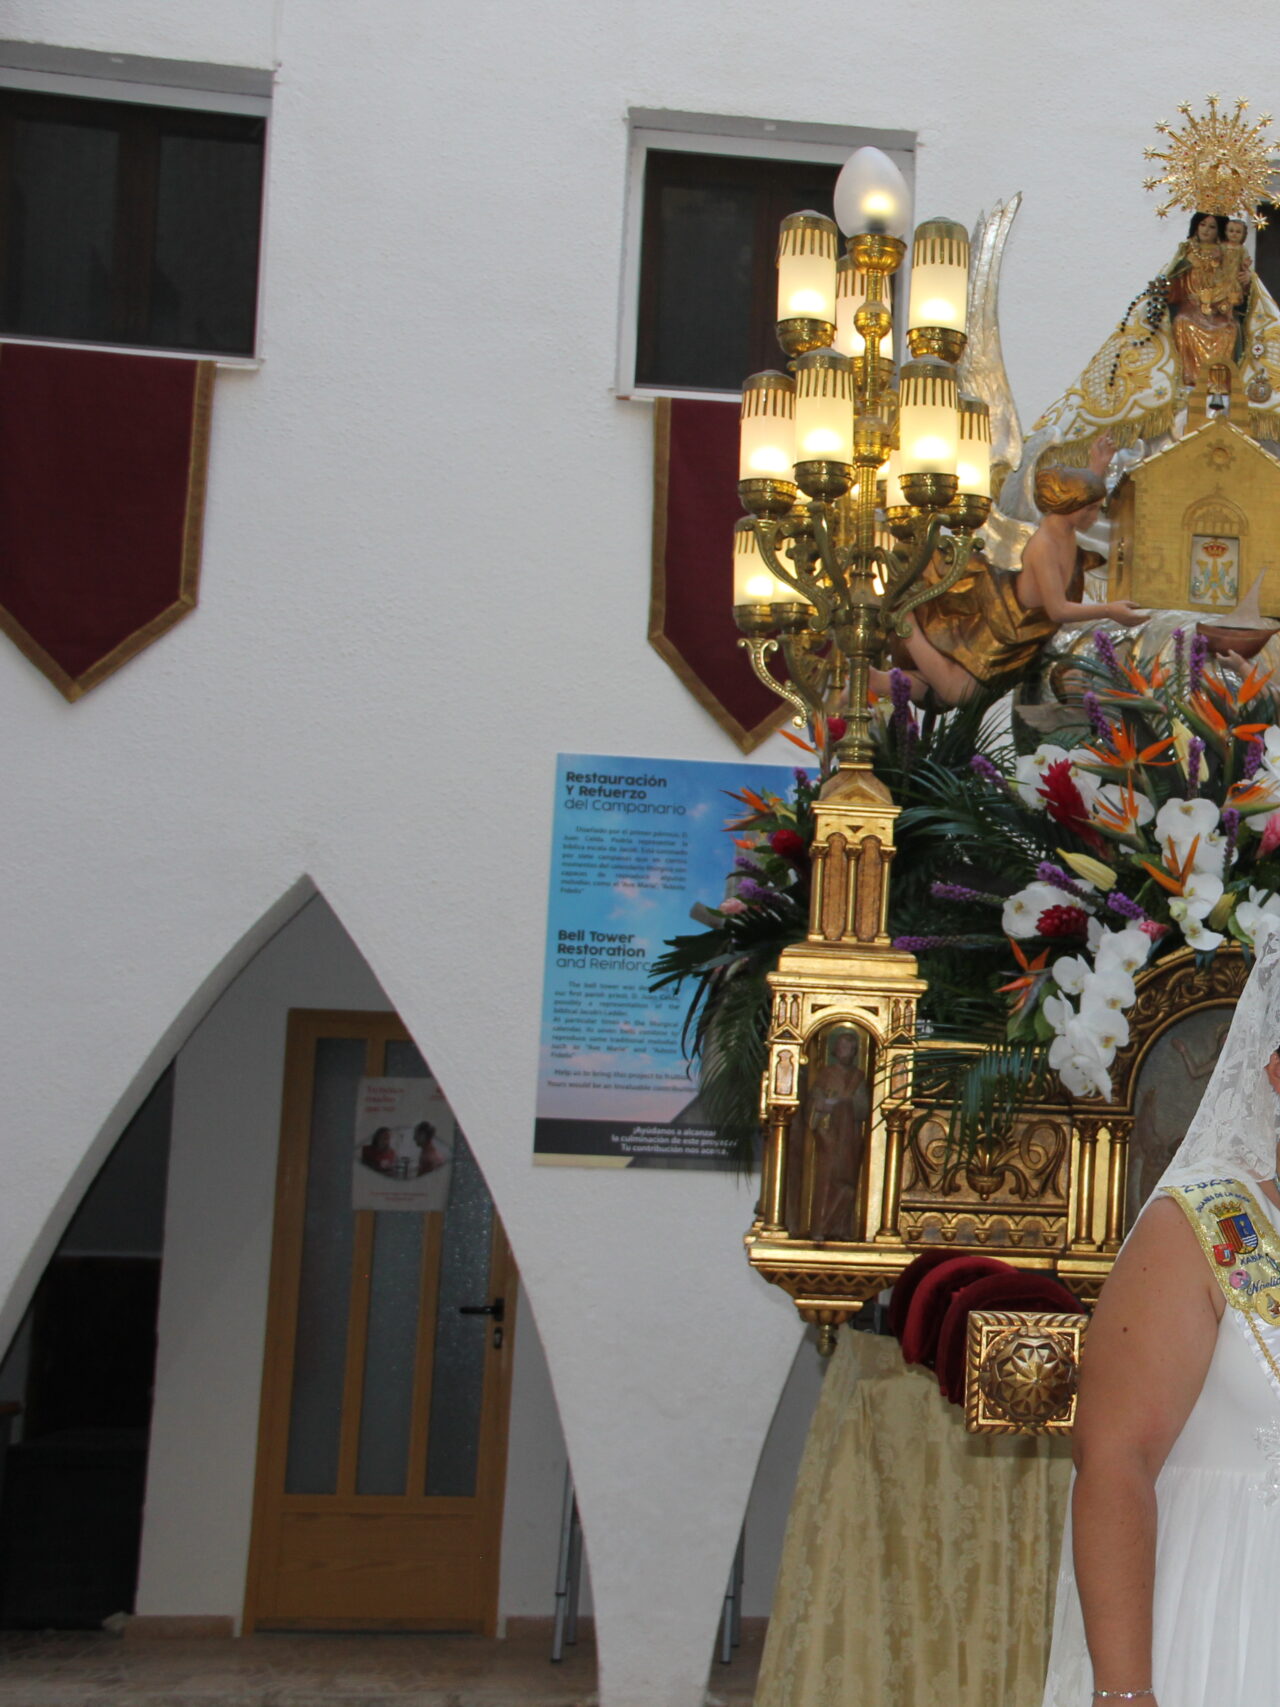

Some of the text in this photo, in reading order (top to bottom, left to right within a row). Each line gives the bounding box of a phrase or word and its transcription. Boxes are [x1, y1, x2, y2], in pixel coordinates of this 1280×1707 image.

[566, 771, 668, 788] Restauración
[566, 785, 648, 800] Y Refuerzo
[564, 798, 687, 816] del Campanario
[558, 929, 636, 943] Bell Tower
[557, 943, 646, 958] Restoration
[555, 957, 652, 972] and Reinforc
